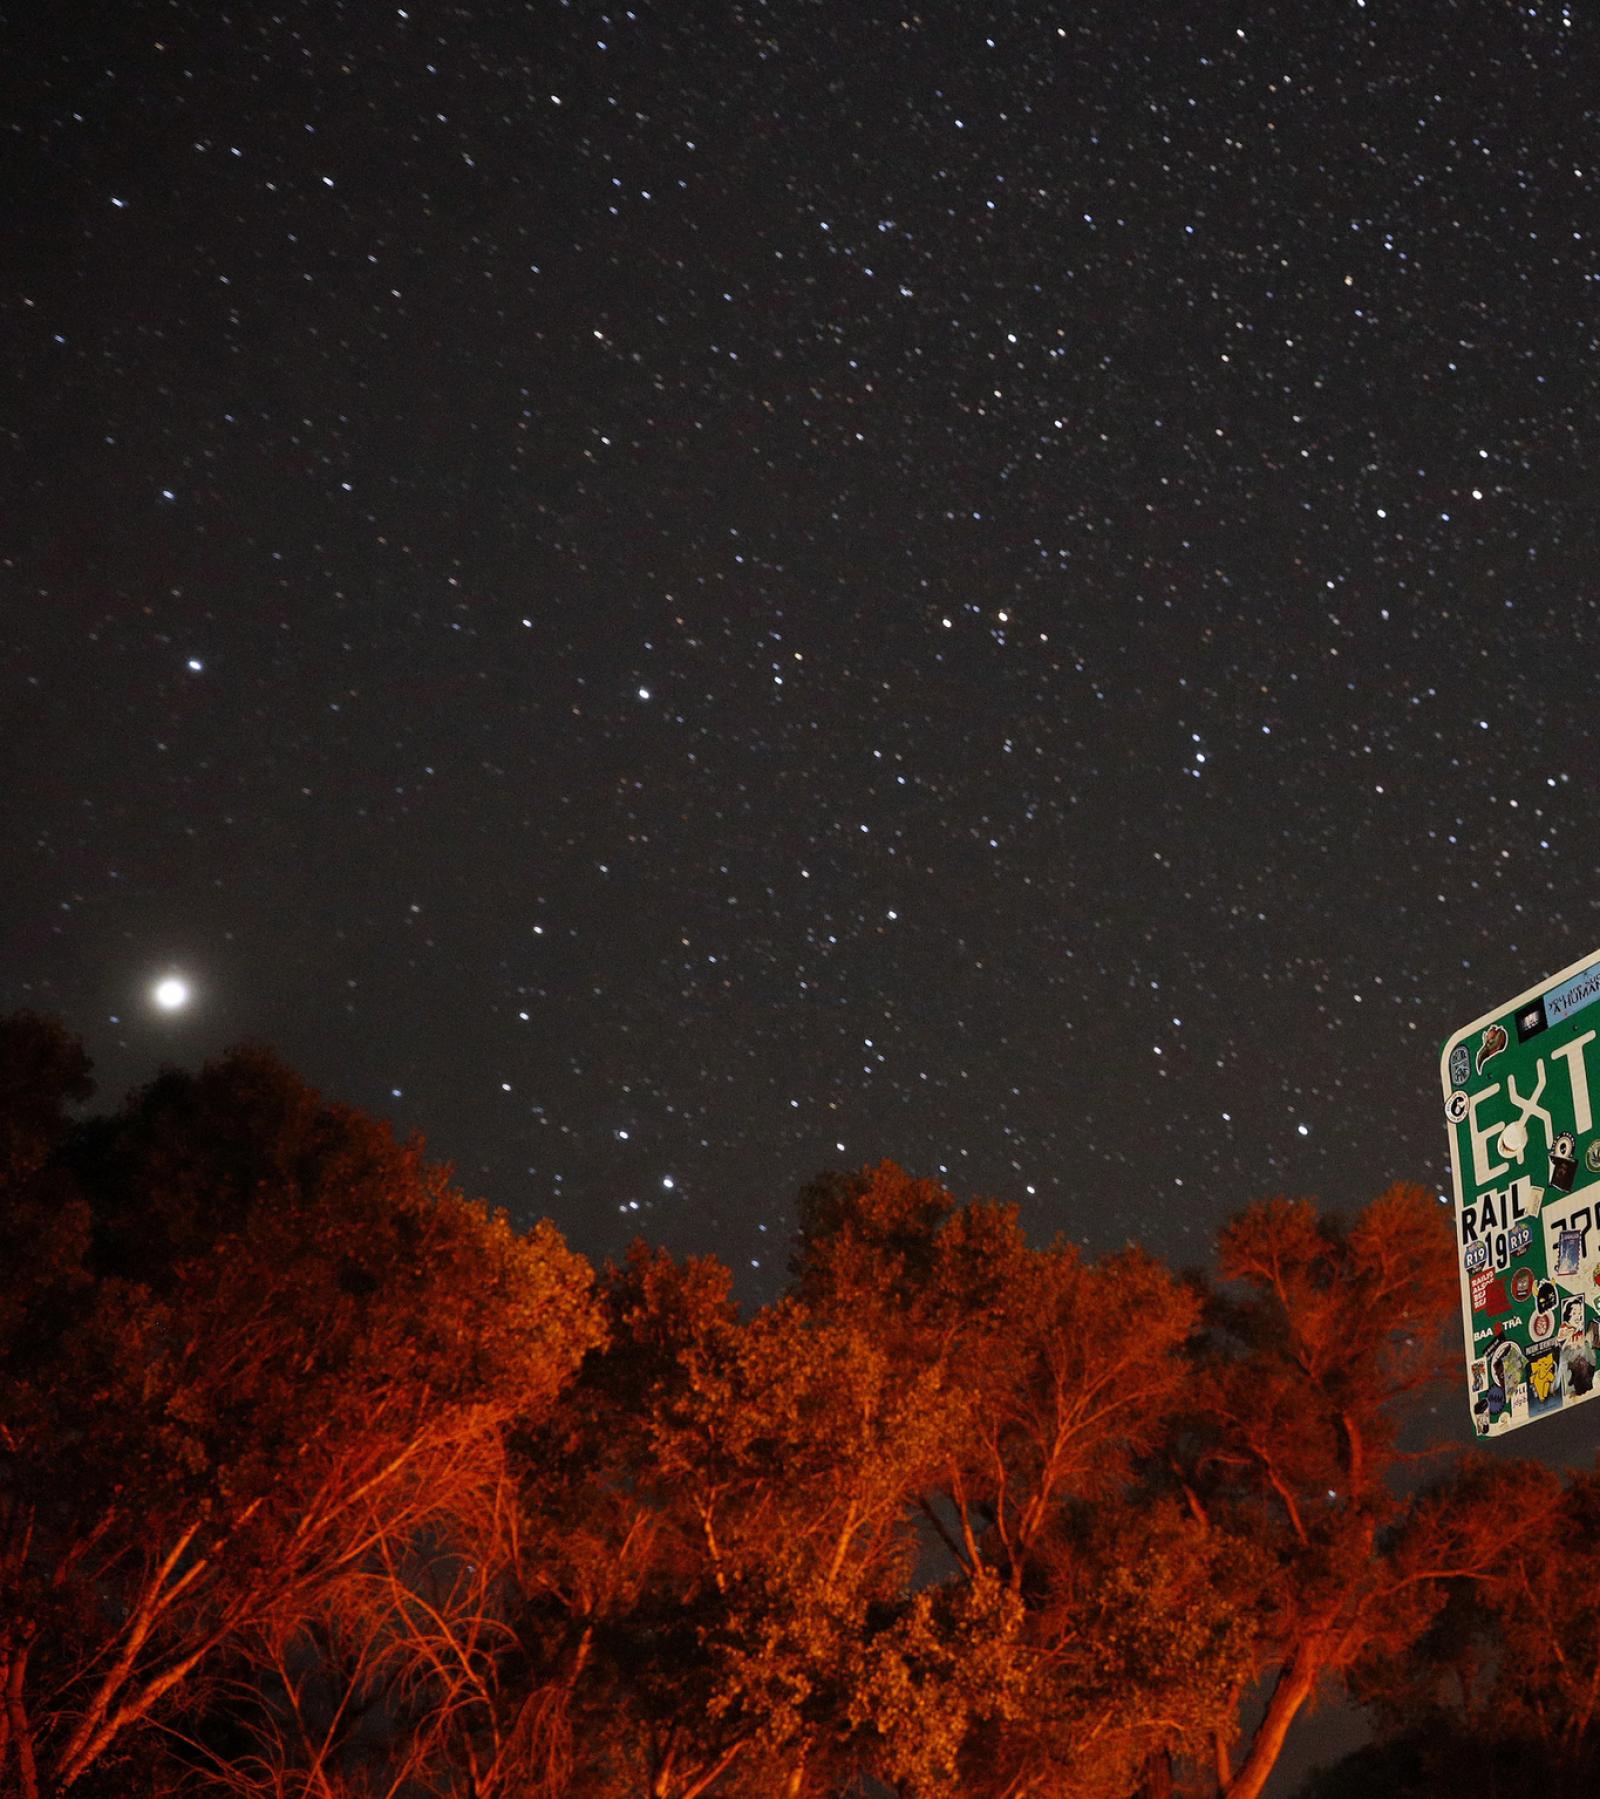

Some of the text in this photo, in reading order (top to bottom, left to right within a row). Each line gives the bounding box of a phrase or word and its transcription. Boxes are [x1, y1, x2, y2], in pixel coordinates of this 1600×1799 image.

[1461, 1183, 1527, 1245] RAIL
[1485, 1231, 1507, 1269] 19
[1511, 1230, 1530, 1249] R19
[1466, 1248, 1485, 1266] R19
